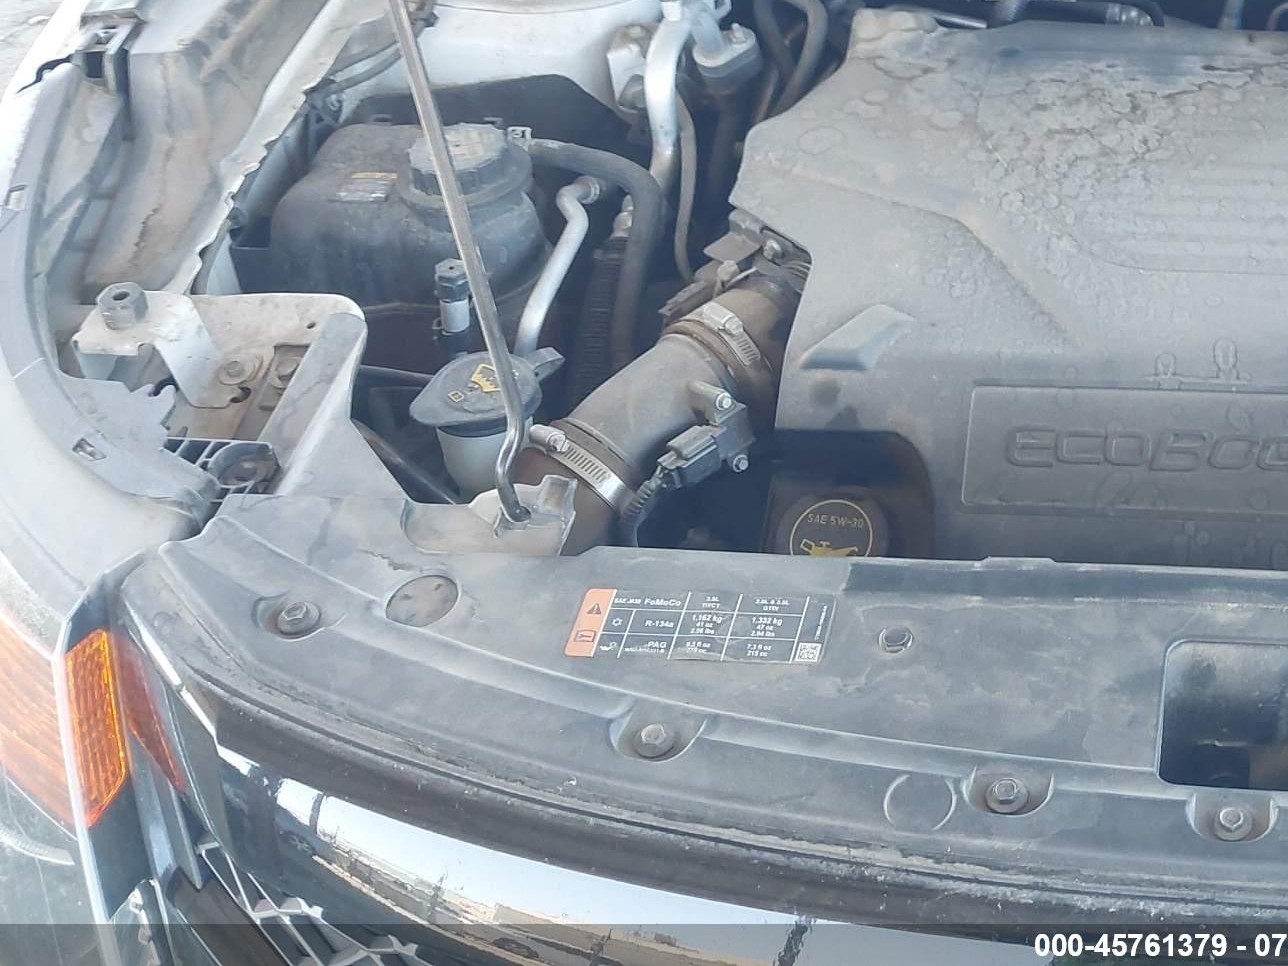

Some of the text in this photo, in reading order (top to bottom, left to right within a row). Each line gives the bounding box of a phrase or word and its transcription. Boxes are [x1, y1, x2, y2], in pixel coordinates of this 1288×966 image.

[807, 514, 864, 529] SAE 5W-30
[644, 598, 681, 607] FoMoCo
[645, 619, 674, 628] R-134a
[713, 615, 723, 624] kg
[751, 616, 783, 626] 1,332 kg
[647, 640, 667, 649] PAG
